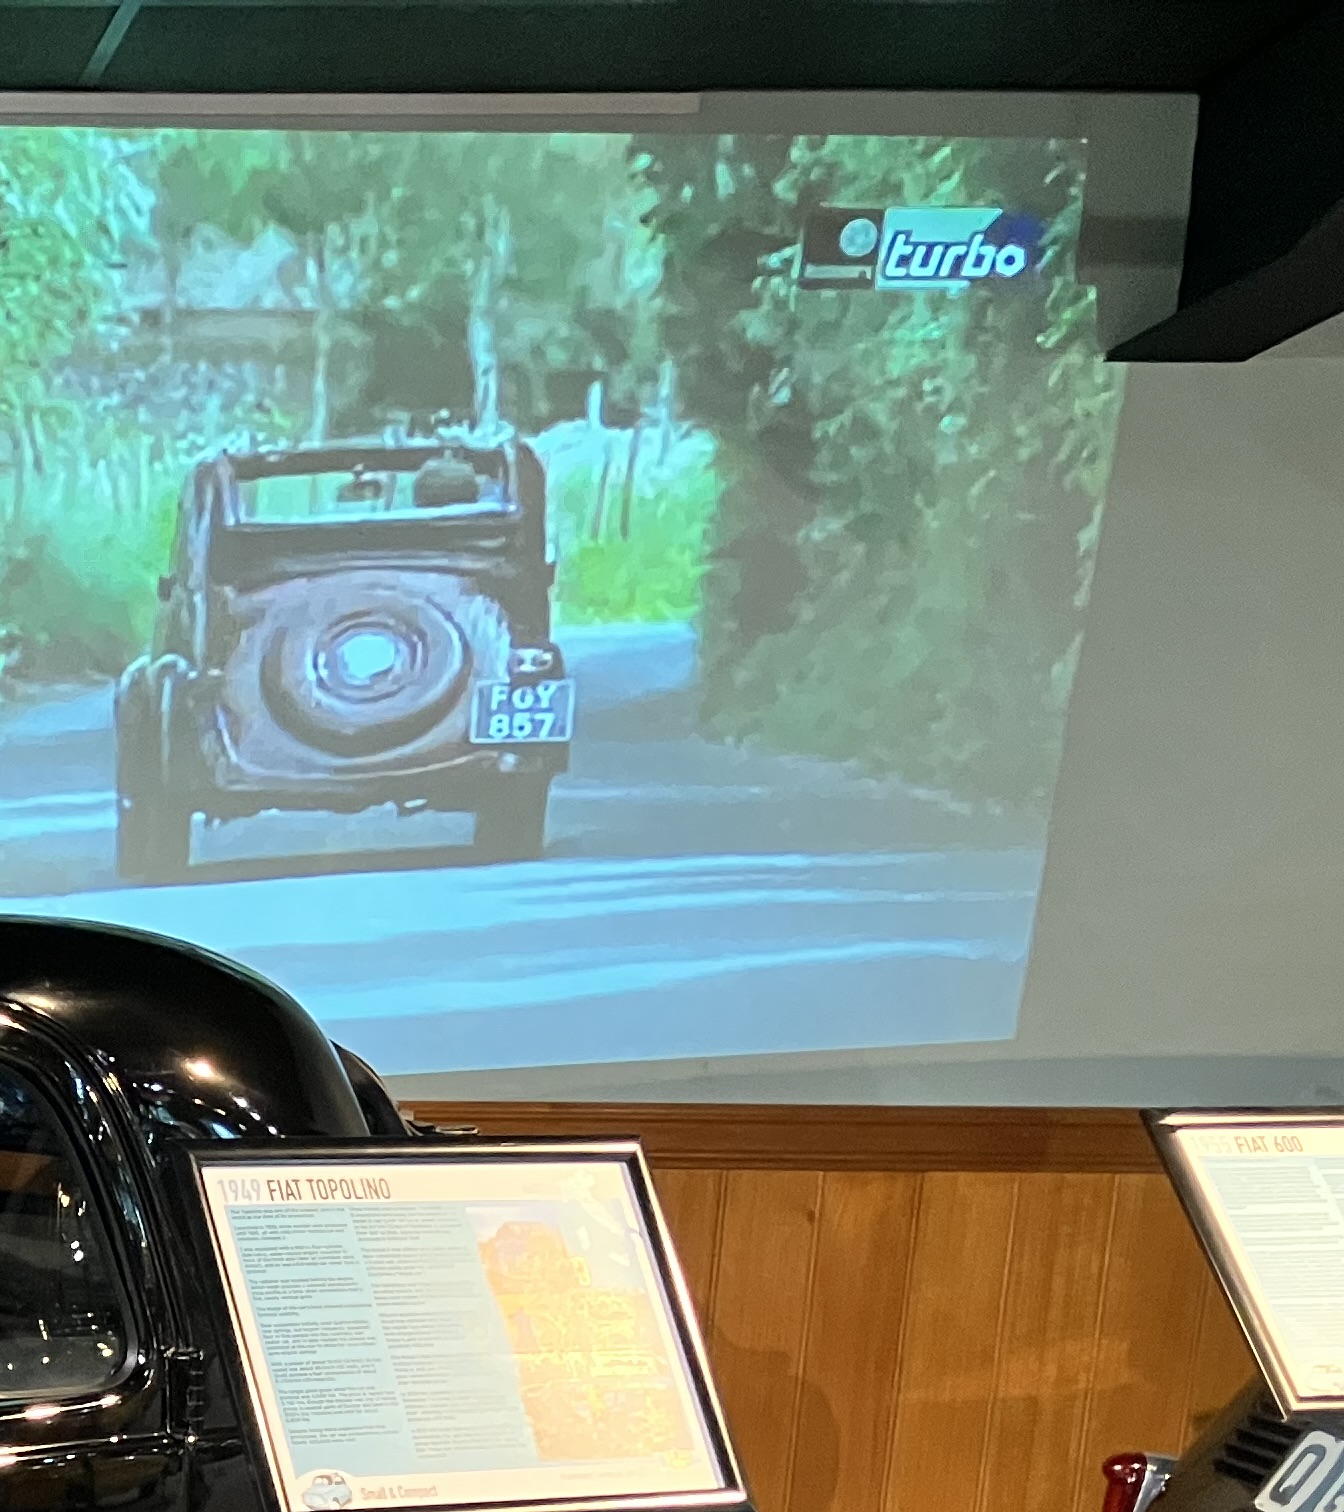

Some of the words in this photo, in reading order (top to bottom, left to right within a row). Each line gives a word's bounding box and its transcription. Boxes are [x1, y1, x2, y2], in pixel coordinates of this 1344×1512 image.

[885, 231, 1026, 278] turbo
[489, 711, 555, 739] 857
[1234, 1135, 1269, 1154] FIAT
[1273, 1135, 1304, 1153] 600
[217, 1178, 261, 1202] 1949
[266, 1178, 303, 1201] FIAT
[305, 1177, 392, 1201] TOPOLINO
